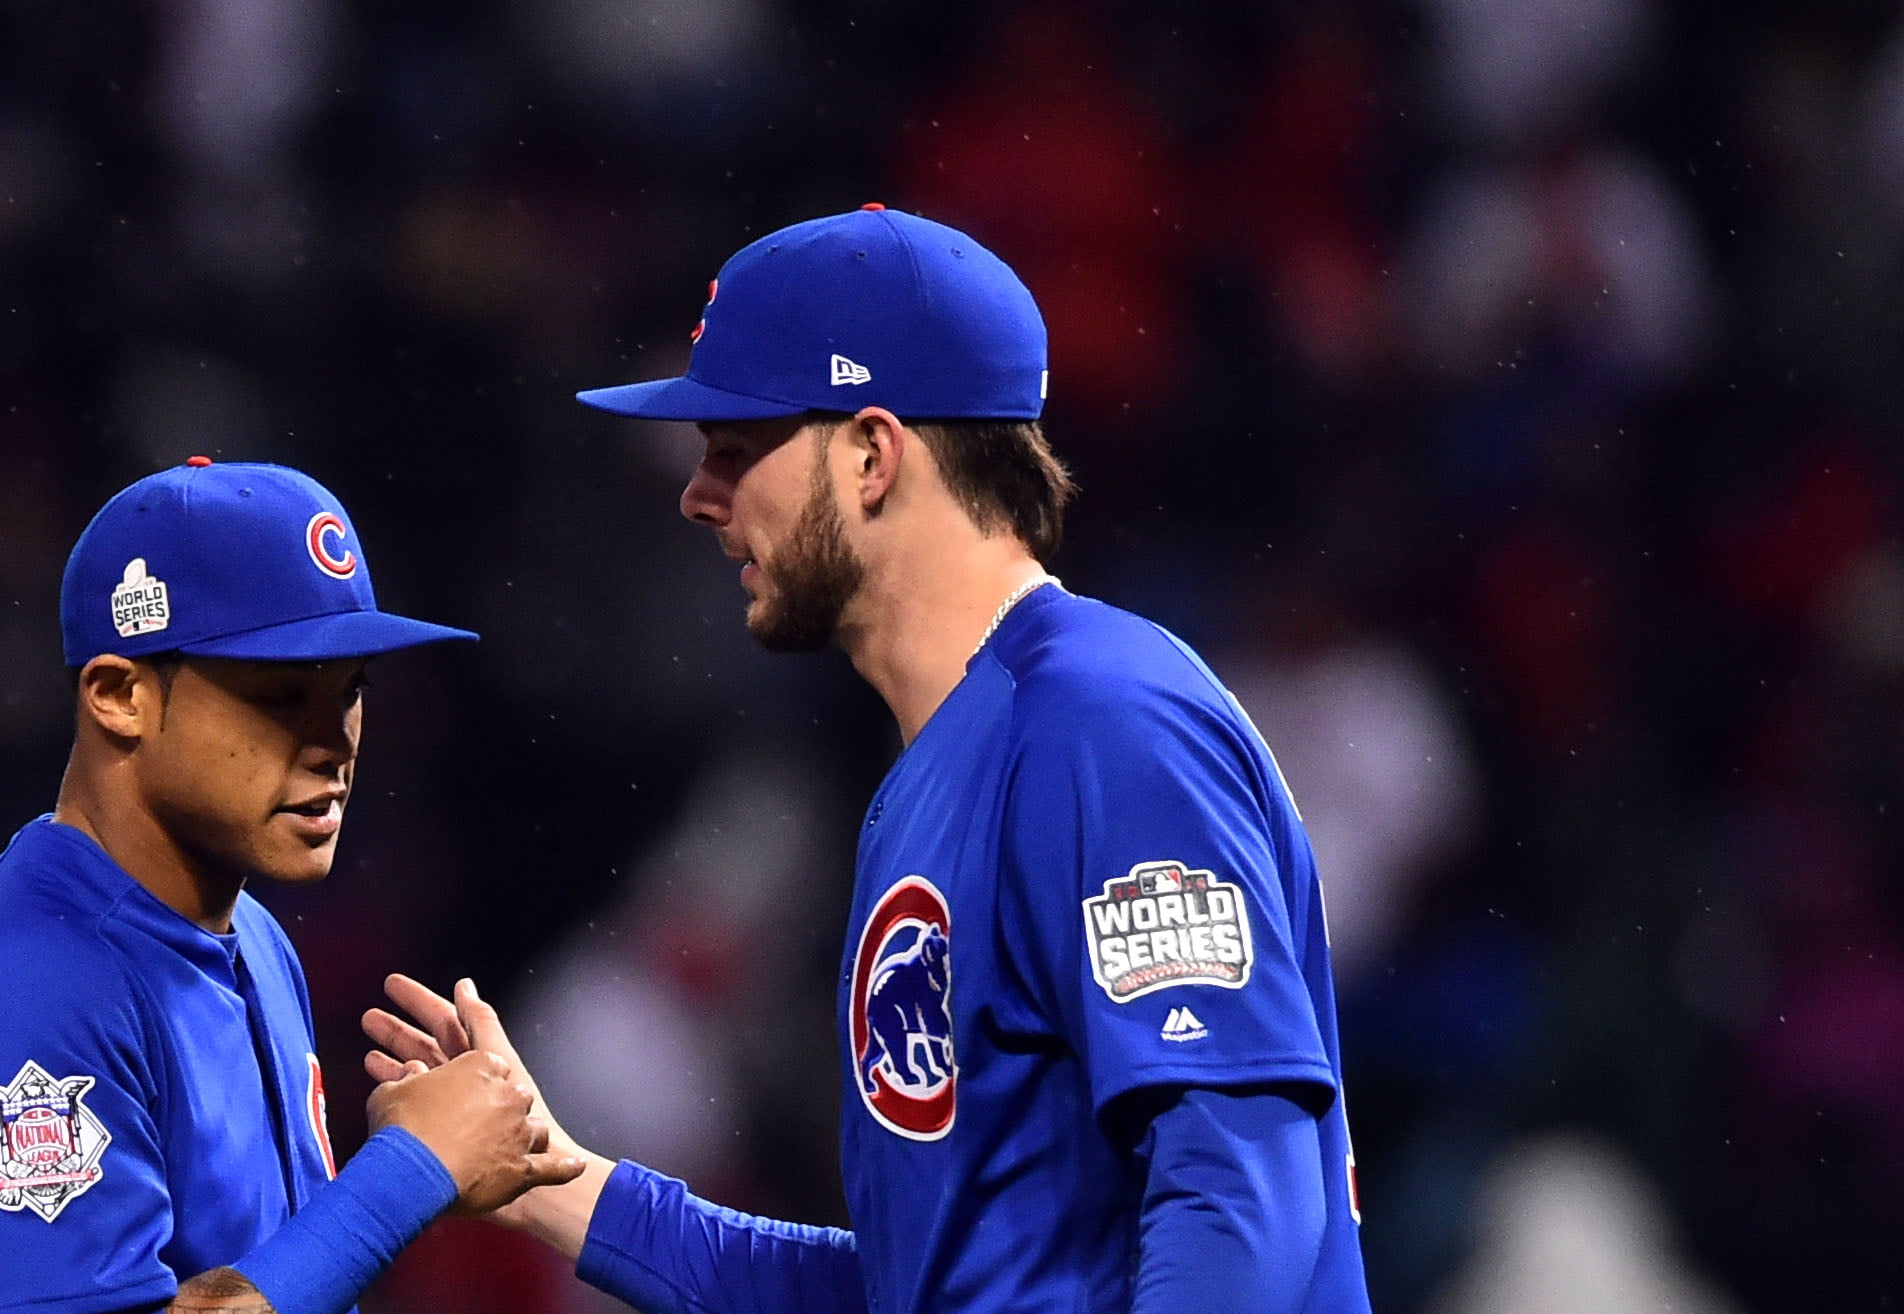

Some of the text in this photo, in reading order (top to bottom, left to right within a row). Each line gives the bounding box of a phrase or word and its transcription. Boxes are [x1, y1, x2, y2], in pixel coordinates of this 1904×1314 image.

[306, 511, 357, 580] C
[113, 586, 163, 608] WORLD
[116, 601, 166, 626] SERIES
[1093, 890, 1235, 936] WORLD
[1099, 924, 1243, 979] SERIES
